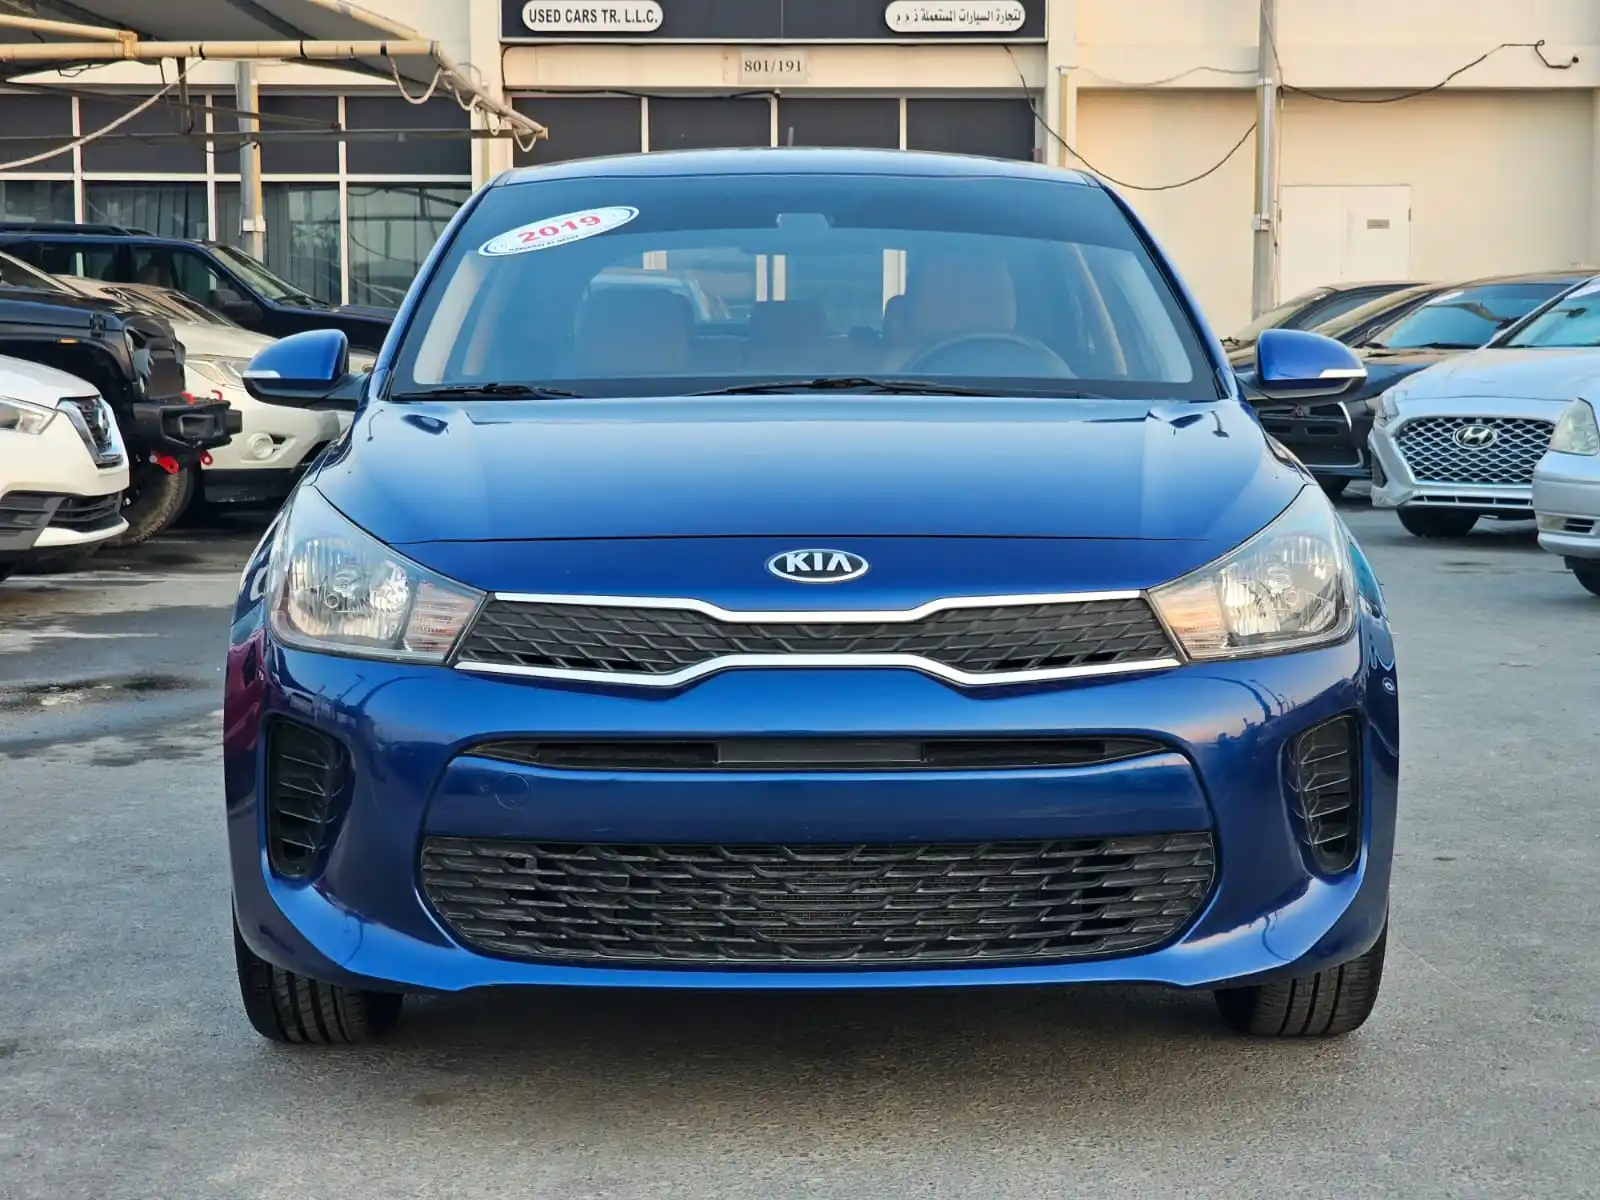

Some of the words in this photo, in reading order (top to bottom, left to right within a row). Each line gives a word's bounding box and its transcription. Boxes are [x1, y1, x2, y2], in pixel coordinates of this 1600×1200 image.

[529, 9, 561, 23] USED
[565, 9, 598, 23] CARS
[601, 9, 621, 23] TR.
[625, 9, 658, 23] L.L.C.
[921, 8, 956, 22] المستعملة
[958, 9, 993, 26] السيارات
[995, 8, 1021, 26] لتجارة
[744, 59, 801, 73] 801/191
[517, 215, 601, 243] 2019
[784, 552, 853, 572] KIA
